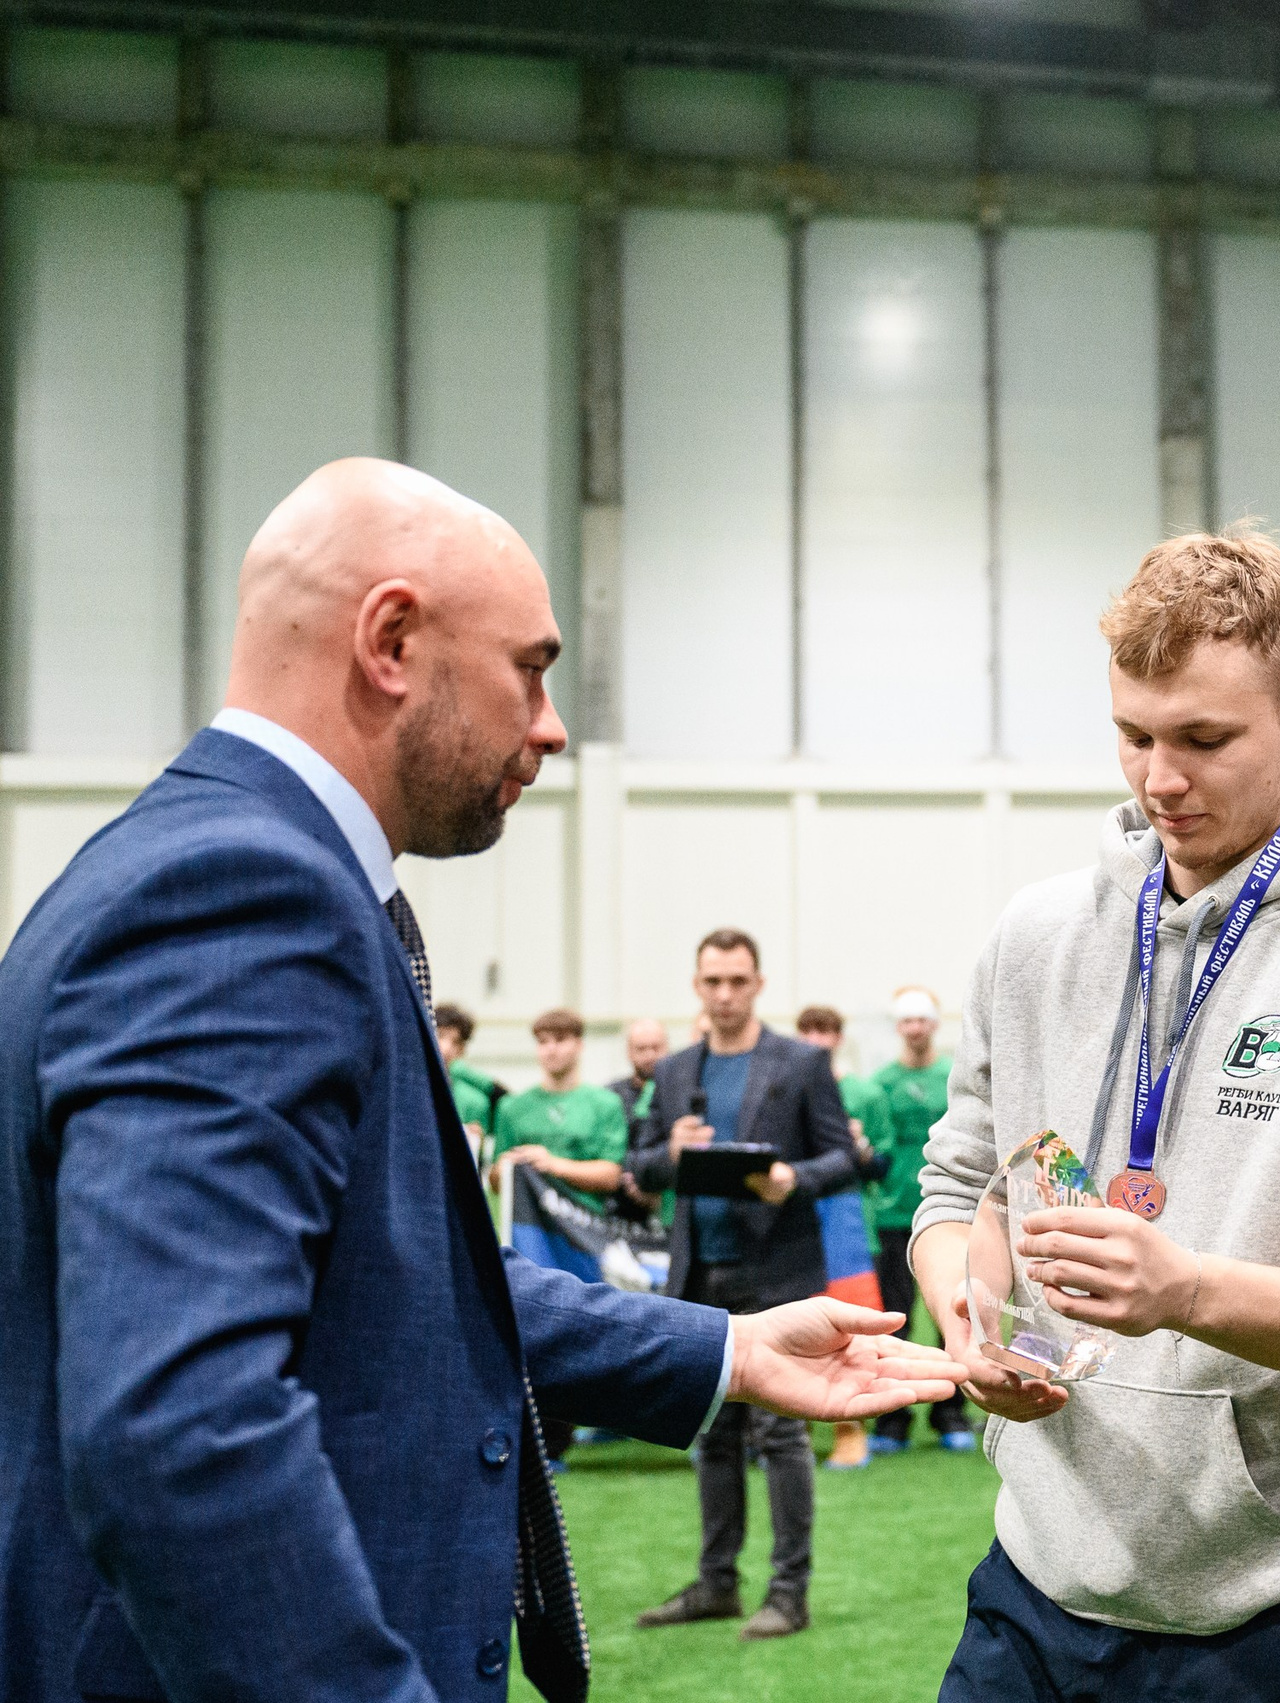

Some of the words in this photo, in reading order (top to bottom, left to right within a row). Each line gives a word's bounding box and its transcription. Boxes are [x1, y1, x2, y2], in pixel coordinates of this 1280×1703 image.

[1141, 887, 1159, 965] ФЕСТИВАЛЬ
[1210, 898, 1256, 974] ФЕСТИВАЛЬ
[1216, 1099, 1280, 1122] ВАРЯГ
[1217, 1086, 1254, 1100] РЕГБИ
